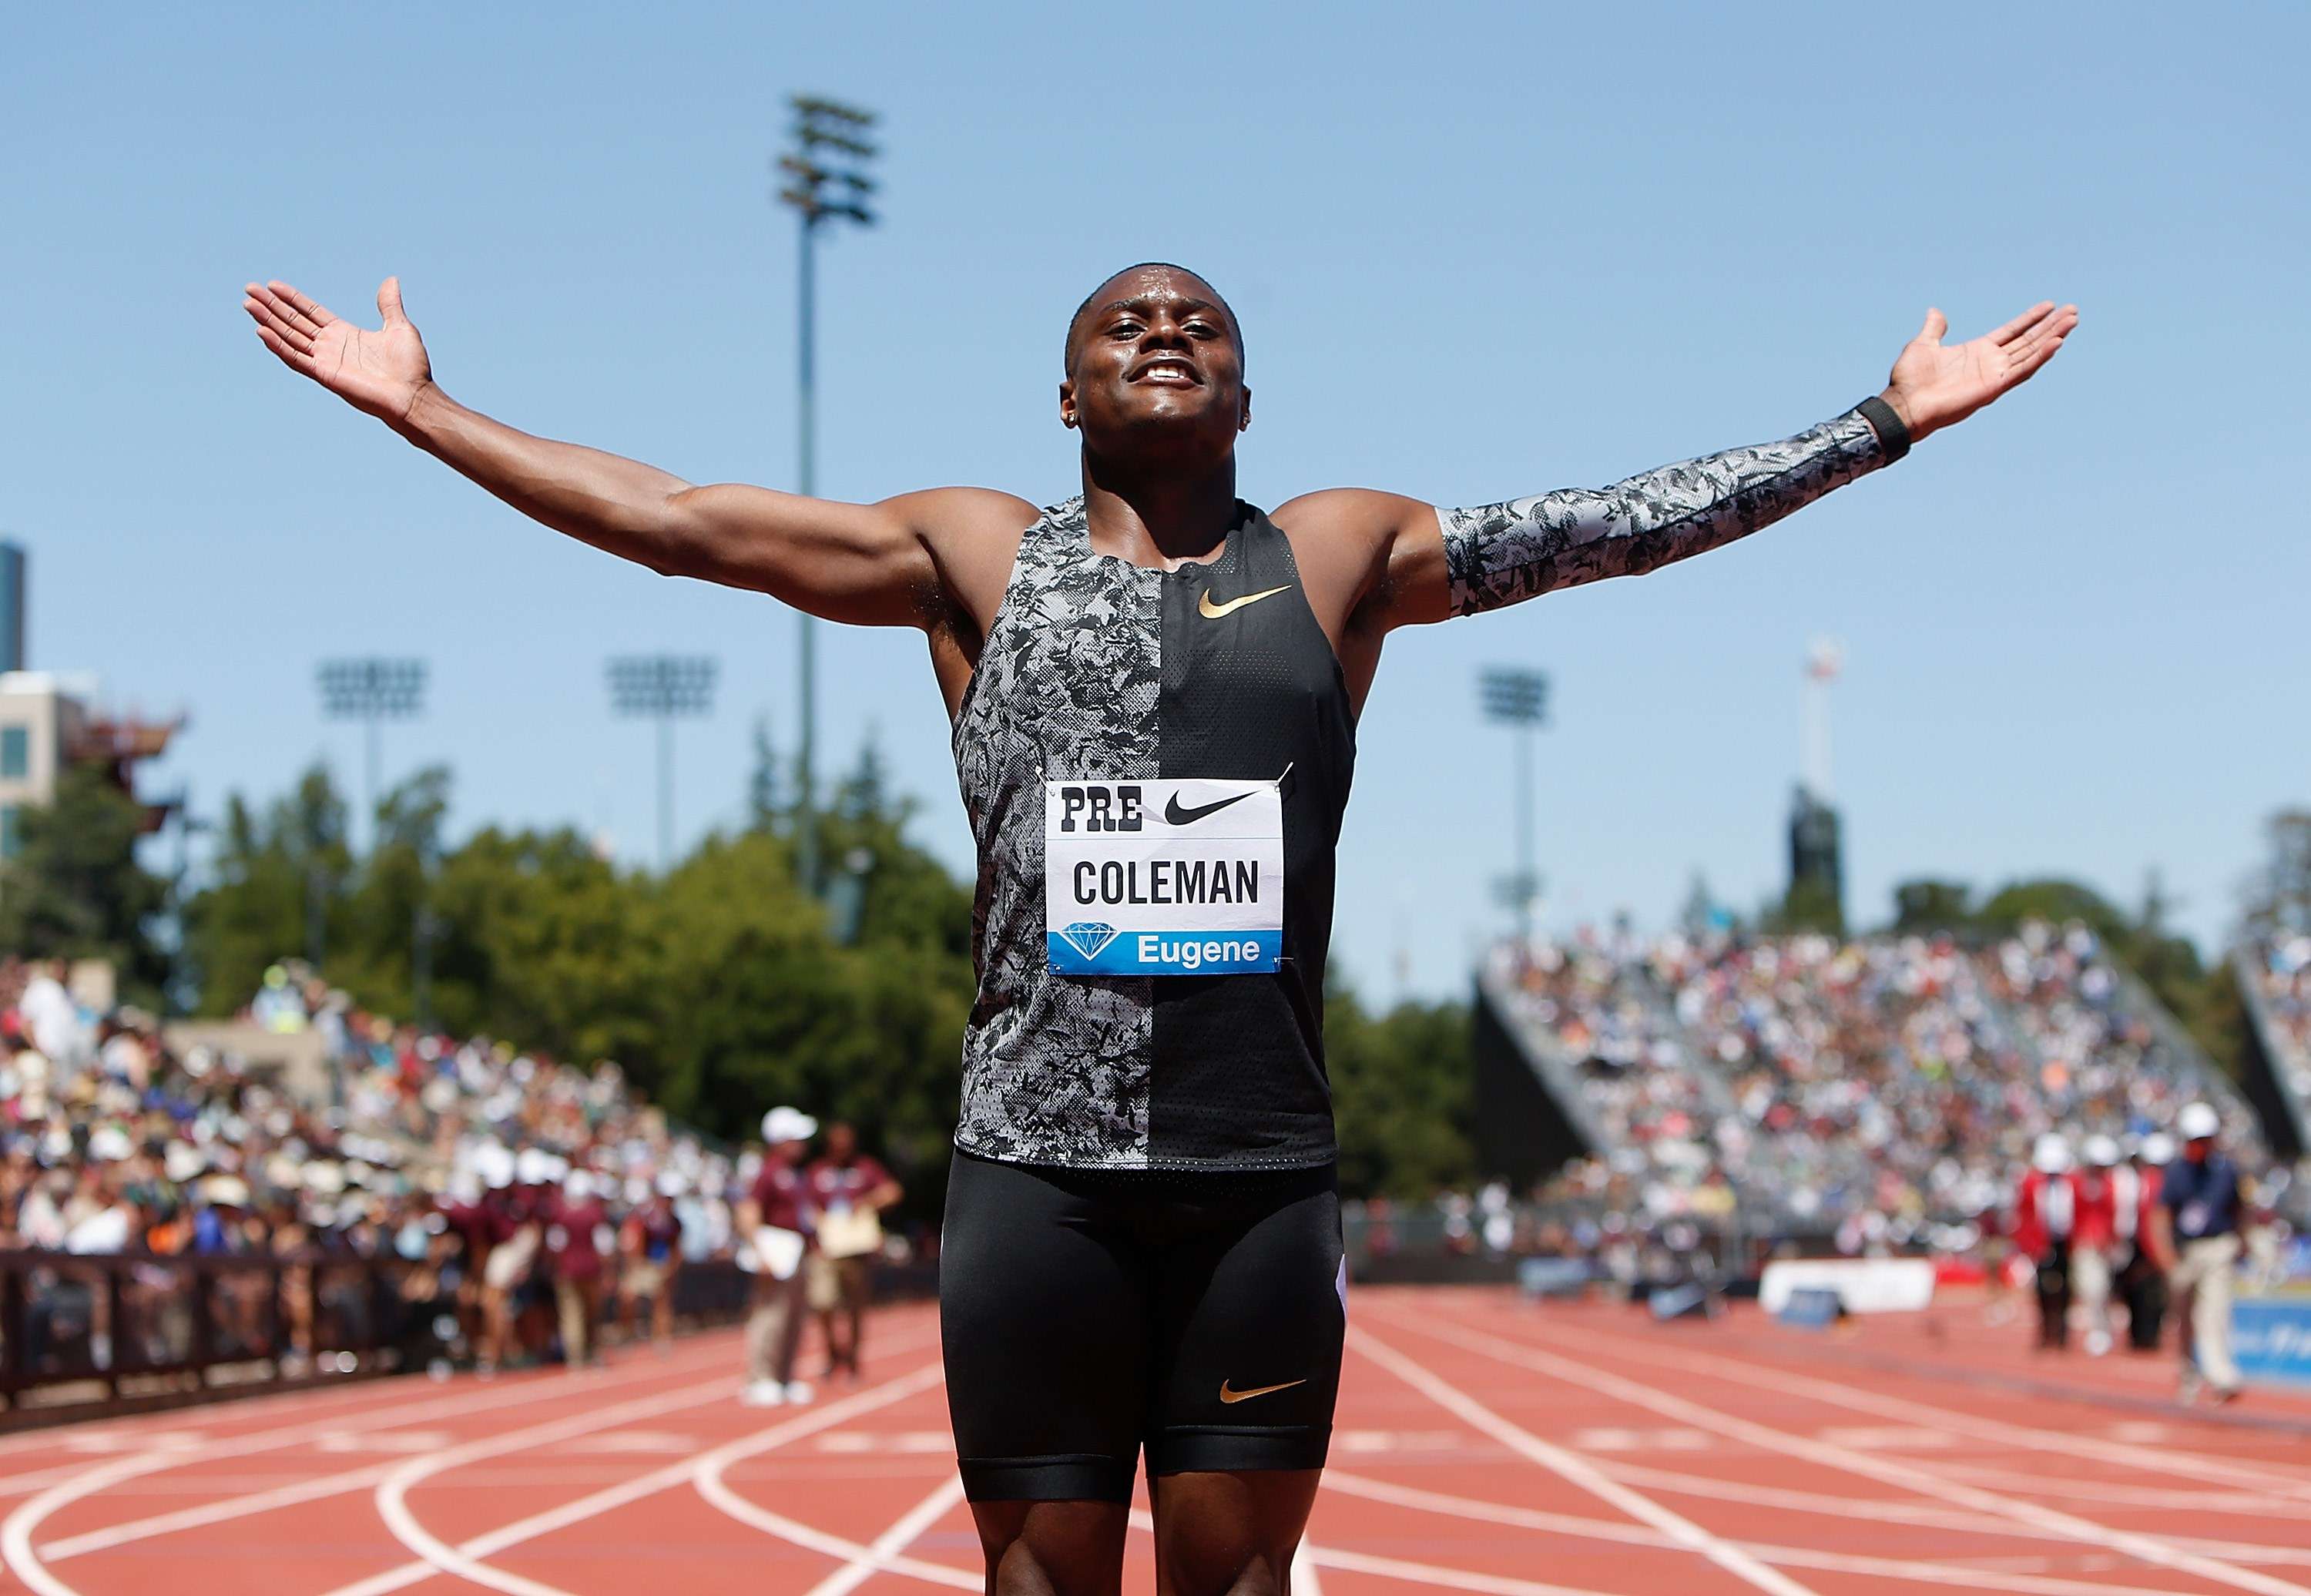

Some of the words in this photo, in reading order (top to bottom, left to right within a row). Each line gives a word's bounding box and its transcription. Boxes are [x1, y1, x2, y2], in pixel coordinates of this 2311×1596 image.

[1061, 786, 1142, 832] PRE
[1074, 860, 1259, 905] COLEMAN
[1138, 935, 1260, 968] Eugene
